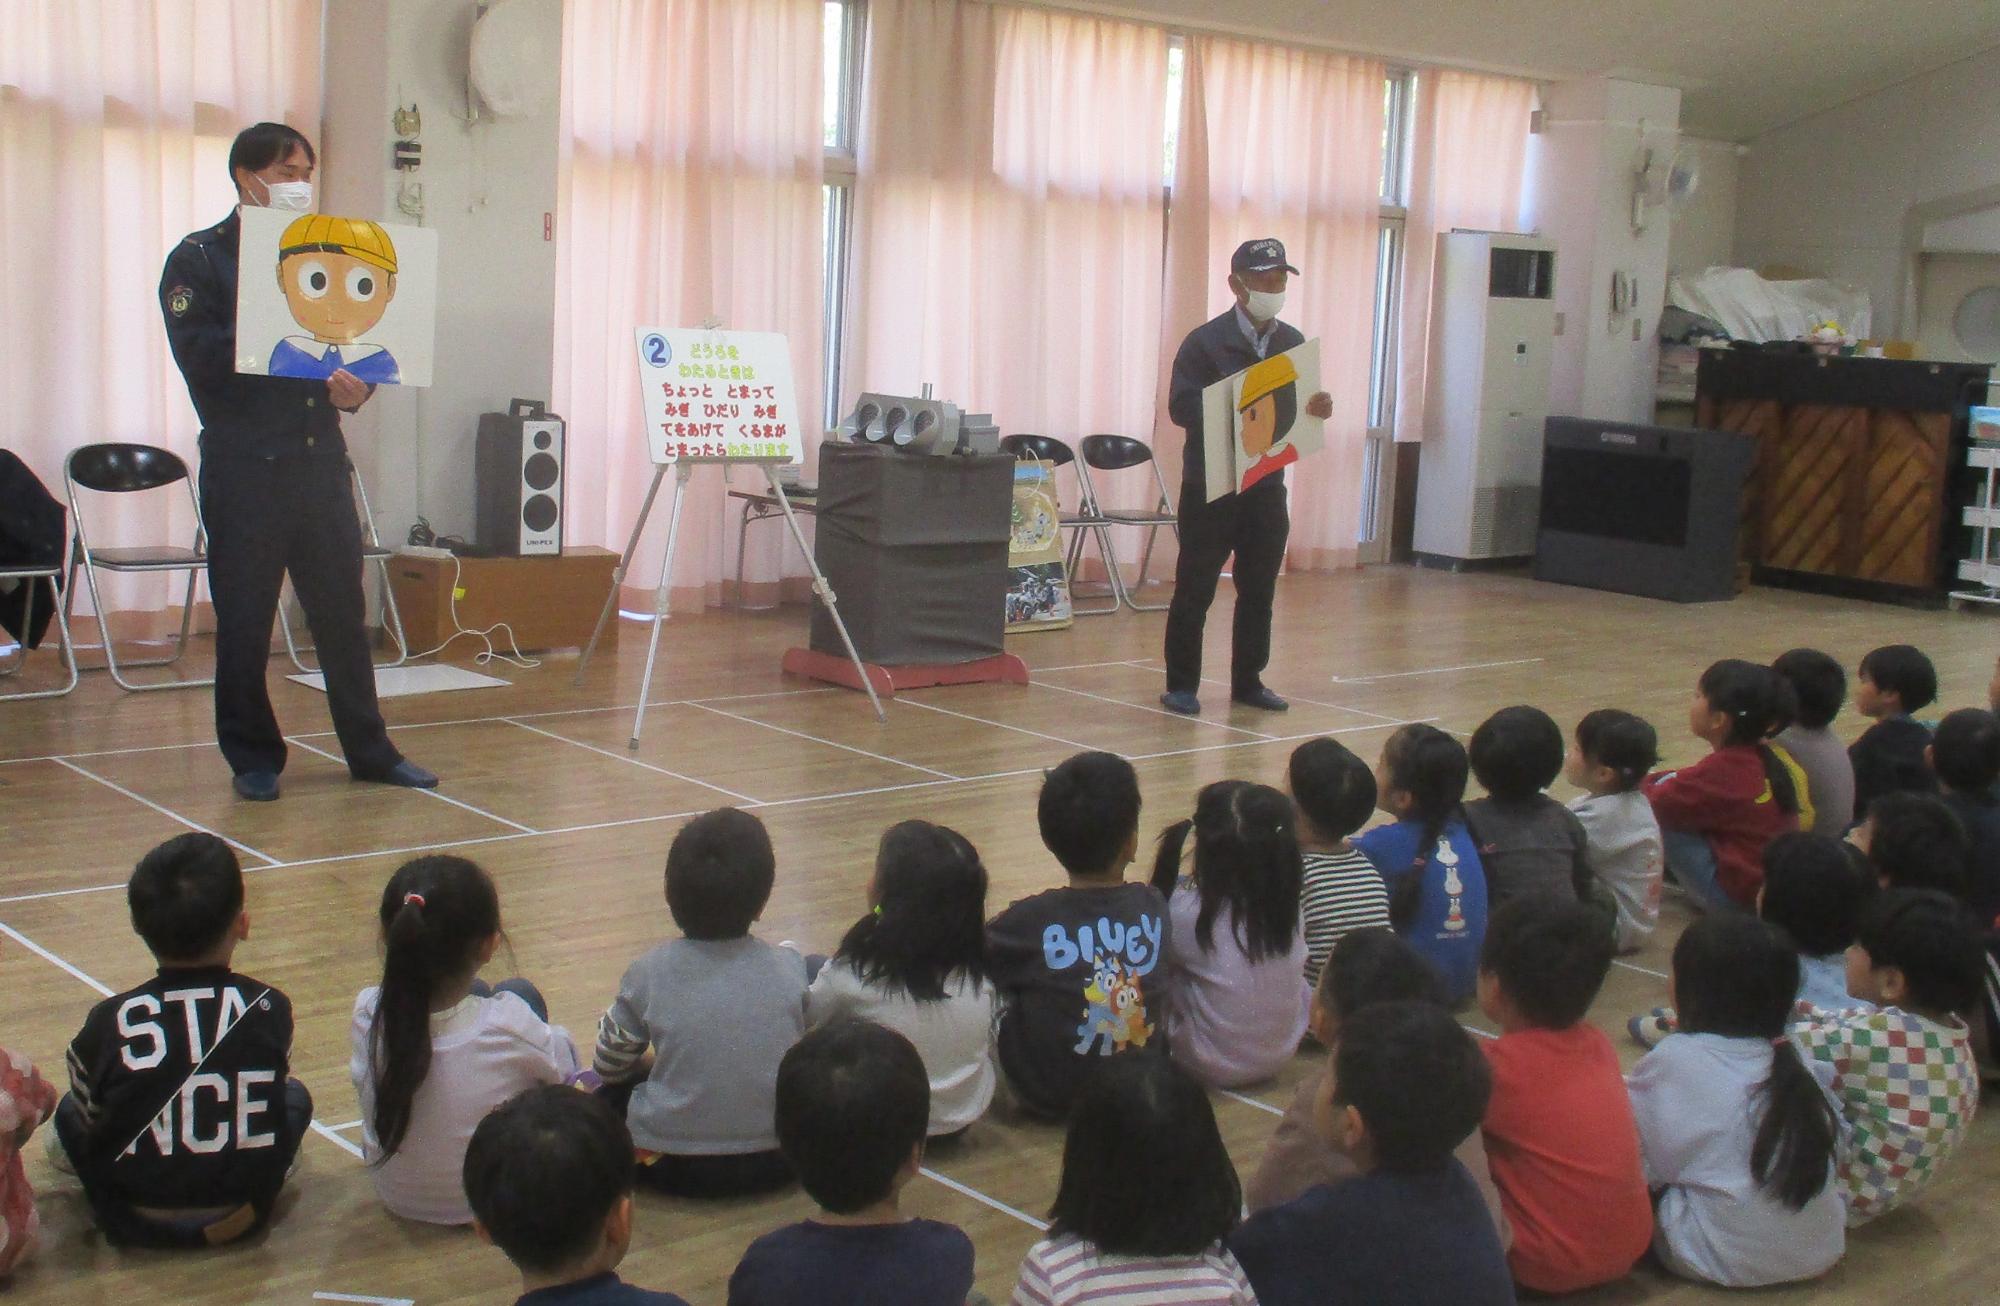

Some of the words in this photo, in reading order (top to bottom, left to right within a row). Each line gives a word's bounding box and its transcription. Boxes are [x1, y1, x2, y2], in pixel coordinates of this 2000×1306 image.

[648, 337, 666, 363] 2
[690, 343, 740, 360] どうろを
[678, 363, 755, 380] わたるときは
[662, 382, 713, 398] ちょっと
[727, 384, 775, 399] とまって
[665, 402, 689, 418] みぎ
[703, 403, 740, 418] ひだり
[754, 404, 777, 419] みぎ
[661, 422, 724, 437] てをあげて
[738, 424, 786, 438] くるまが
